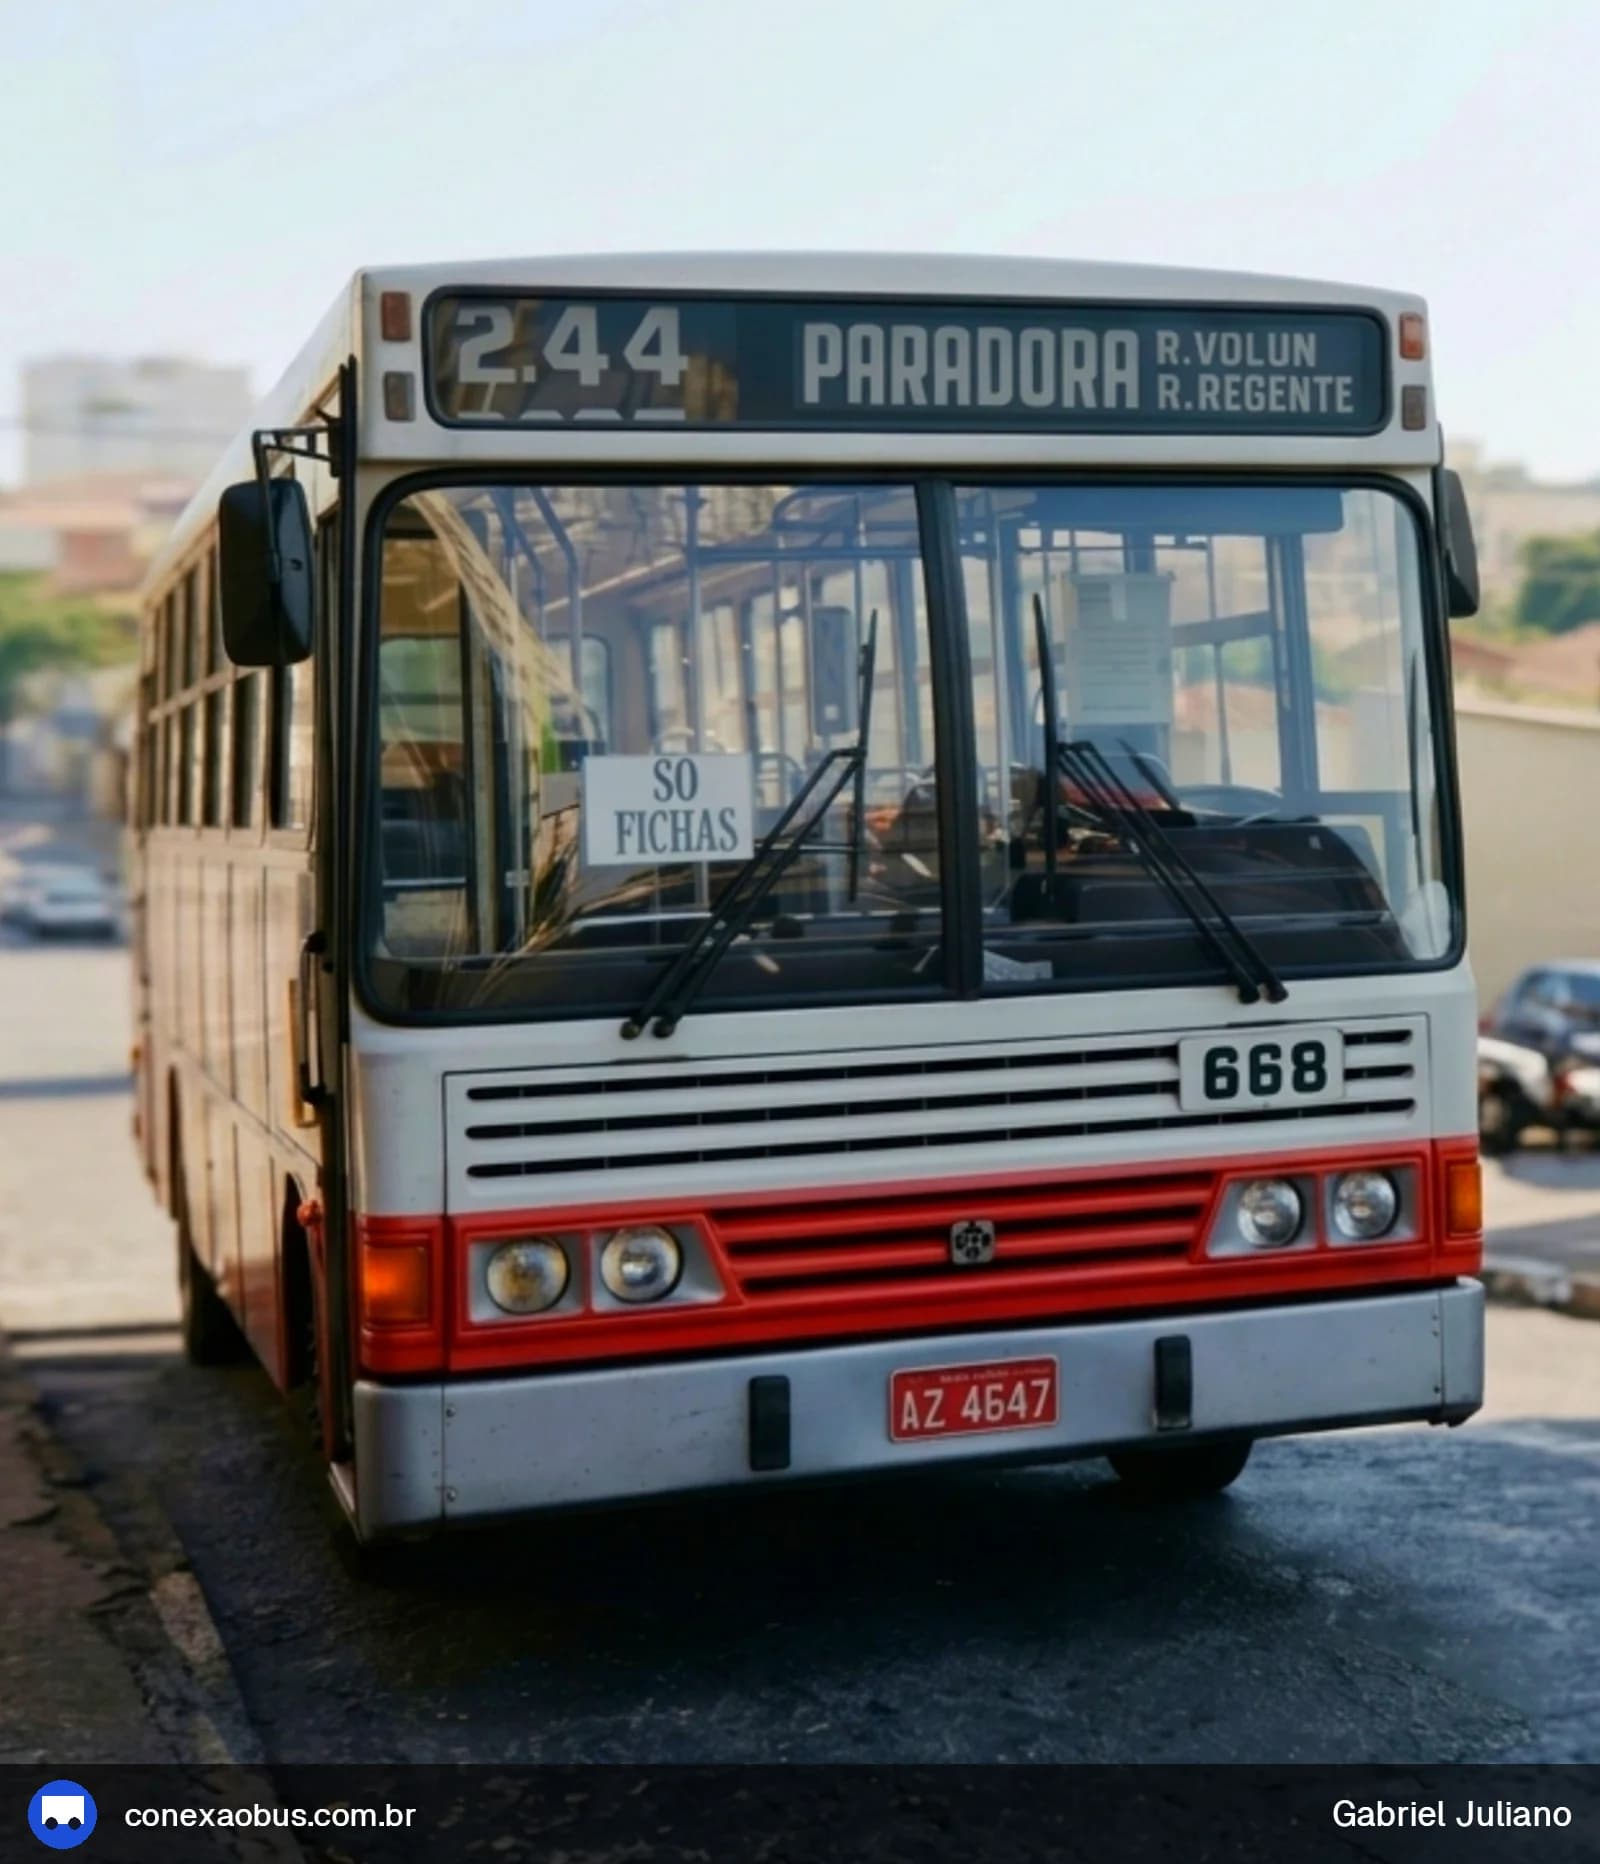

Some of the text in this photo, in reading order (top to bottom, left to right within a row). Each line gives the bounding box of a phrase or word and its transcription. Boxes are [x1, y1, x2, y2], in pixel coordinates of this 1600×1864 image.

[456, 305, 689, 386] 2.44
[803, 322, 1140, 409] PARADORA
[653, 757, 698, 802] SO
[614, 807, 739, 855] FICHAS
[1204, 1040, 1327, 1100] 668
[901, 1378, 1051, 1430] AZ 4647
